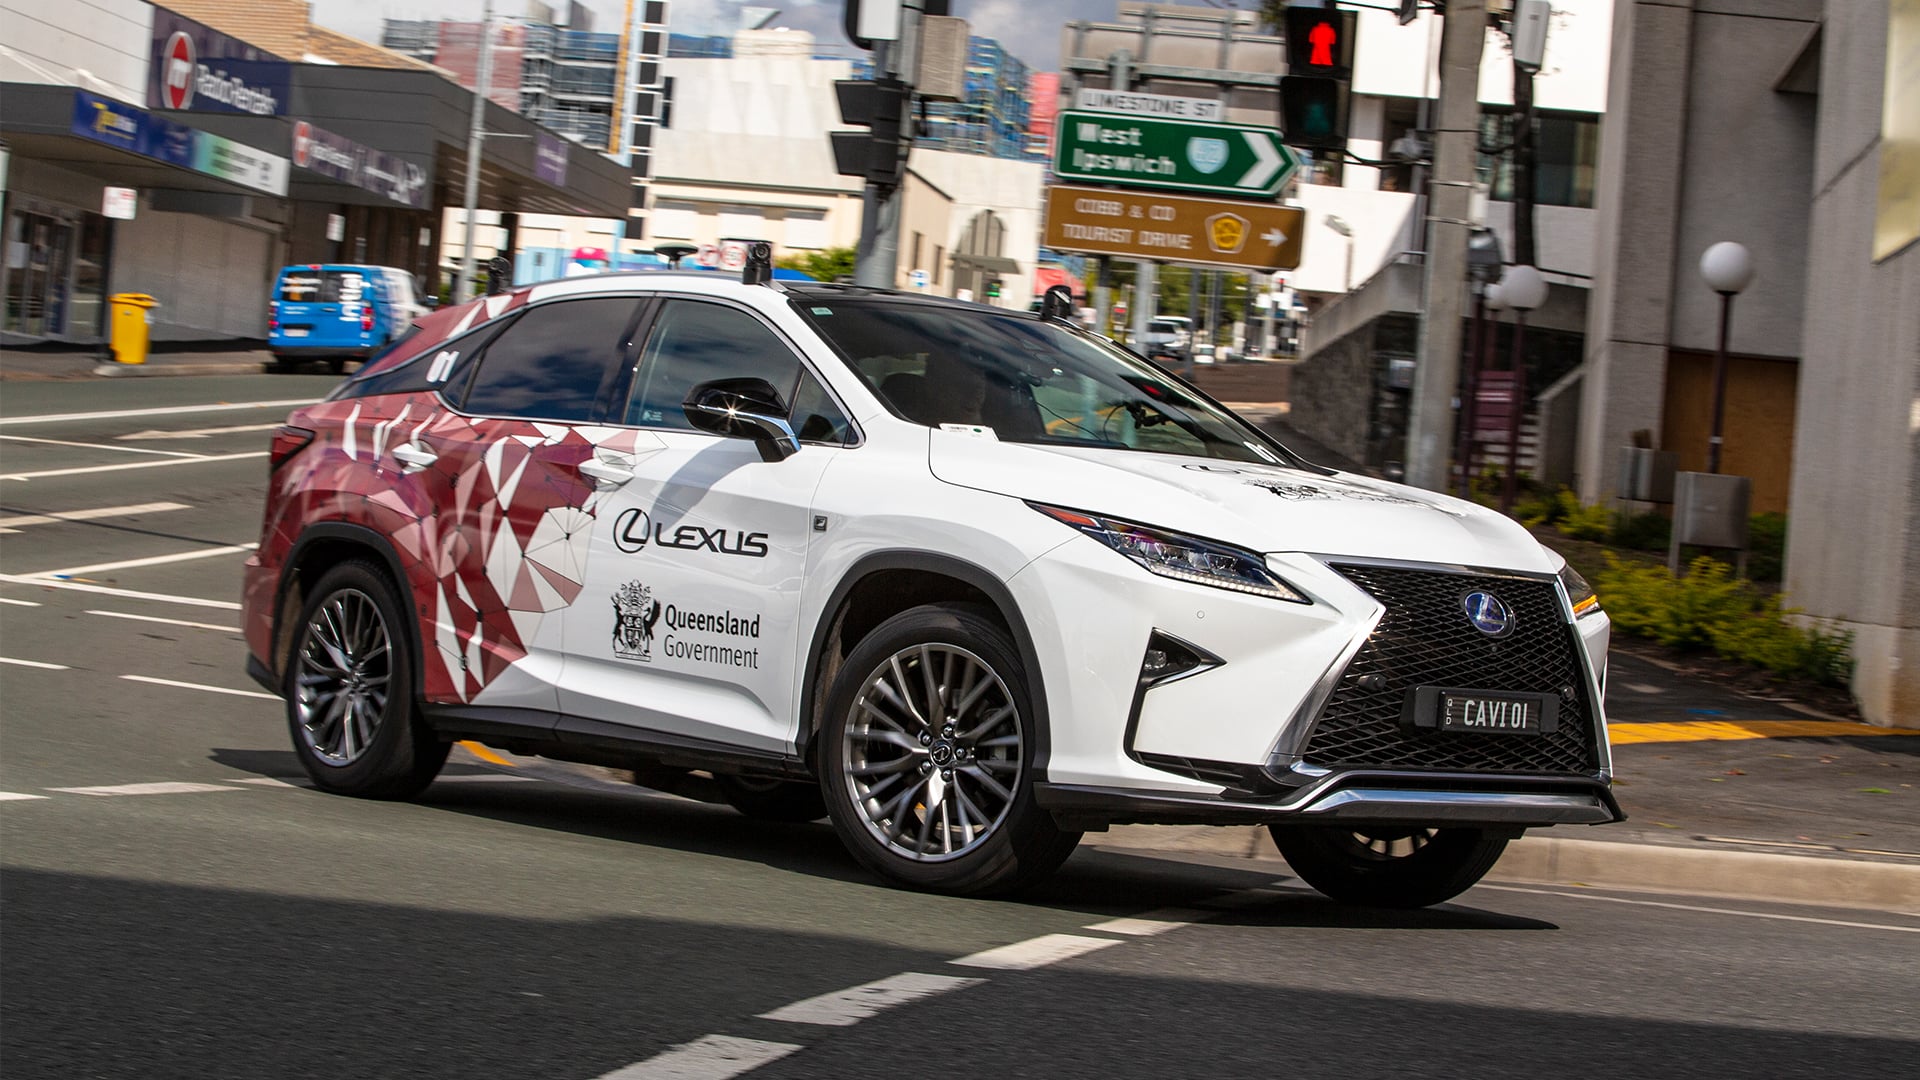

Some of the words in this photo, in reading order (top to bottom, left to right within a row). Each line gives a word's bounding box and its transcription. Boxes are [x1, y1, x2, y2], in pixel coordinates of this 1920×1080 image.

[1082, 93, 1186, 115] LIMESTONE
[1194, 102, 1217, 118] ST
[1076, 122, 1143, 146] West
[1072, 148, 1177, 175] Ipswich
[1074, 198, 1125, 217] COBB
[1129, 205, 1144, 219] &
[1149, 204, 1177, 222] CO
[1062, 223, 1134, 244] TOURIST
[1138, 230, 1193, 250] DRIVE
[655, 522, 769, 558] LEXUS
[665, 604, 761, 638] Queensland
[664, 634, 759, 669] Government
